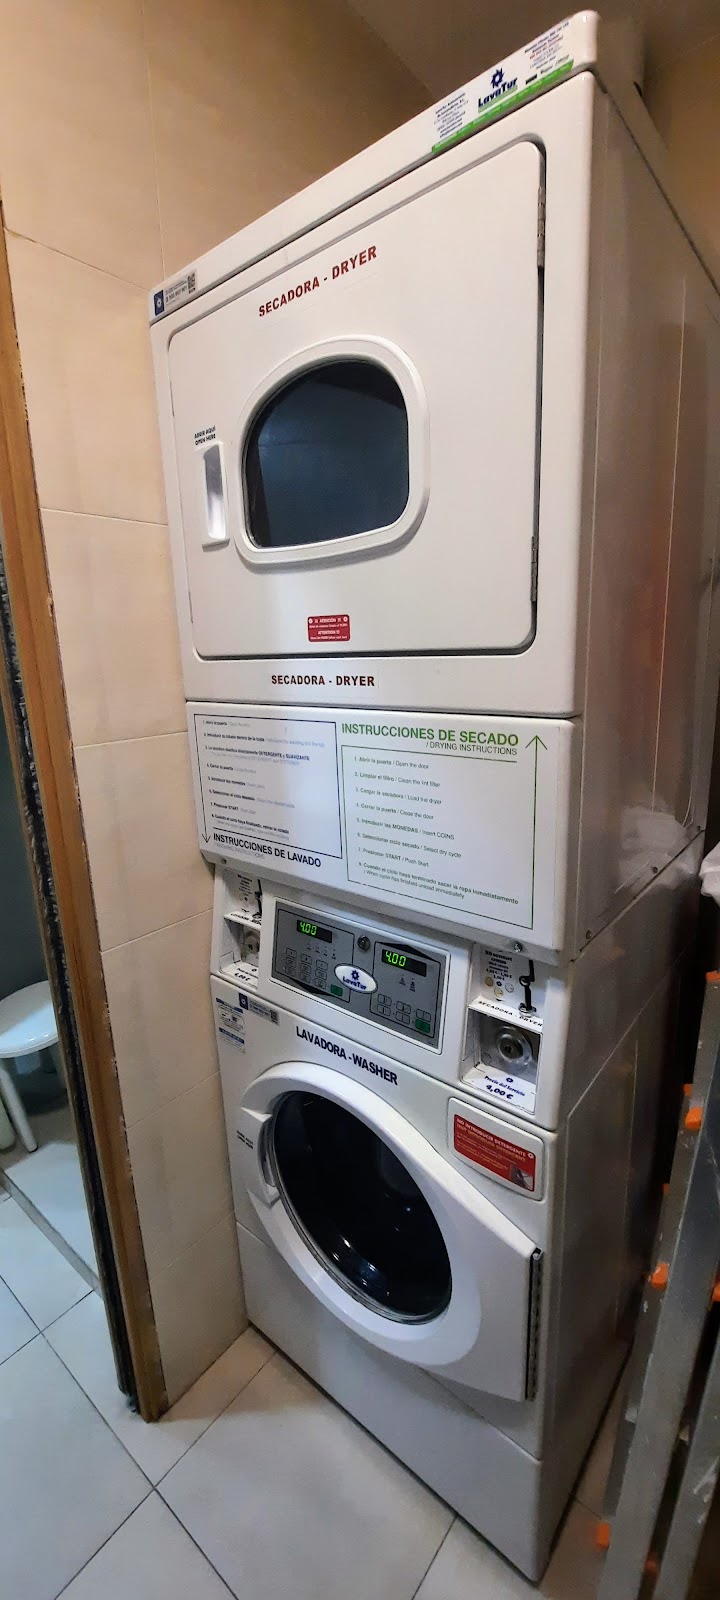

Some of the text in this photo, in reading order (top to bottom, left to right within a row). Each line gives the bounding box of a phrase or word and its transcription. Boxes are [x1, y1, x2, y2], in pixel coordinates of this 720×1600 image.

[478, 78, 518, 108] LavaTur
[258, 276, 320, 317] SECADORA
[332, 246, 377, 280] DRYER
[272, 675, 325, 685] SECADORA
[336, 676, 375, 686] DRYER
[342, 723, 519, 746] INSTRUCCIONES DE SECADO
[430, 741, 457, 750] DRYING
[460, 744, 517, 755] INSTRUCTIONS
[382, 791, 404, 799] secadora
[392, 824, 418, 833] MONEDAS
[437, 832, 454, 840] COINS
[213, 833, 272, 855] INSTRUCCIONES
[274, 849, 285, 858] DE
[287, 851, 321, 867] LAVADO
[362, 833, 388, 842] Seleccionar
[423, 845, 438, 853] Select
[439, 848, 447, 856] dry
[363, 848, 384, 856] Presionar
[385, 852, 401, 861] START
[363, 862, 380, 871] Cuando
[412, 874, 436, 885] terminado
[400, 878, 417, 886] finished
[435, 887, 464, 899] immediately
[343, 976, 367, 990] LavaTur
[478, 1001, 512, 1015] SECADORA
[519, 1016, 542, 1026] DRYER
[484, 1075, 498, 1085] Precio
[508, 1085, 525, 1096] Servicio
[486, 1084, 506, 1096] 4,00
[456, 1118, 464, 1126] NO
[465, 1123, 493, 1141] INTRODUCIR
[494, 1138, 526, 1157] DETERGENTE
